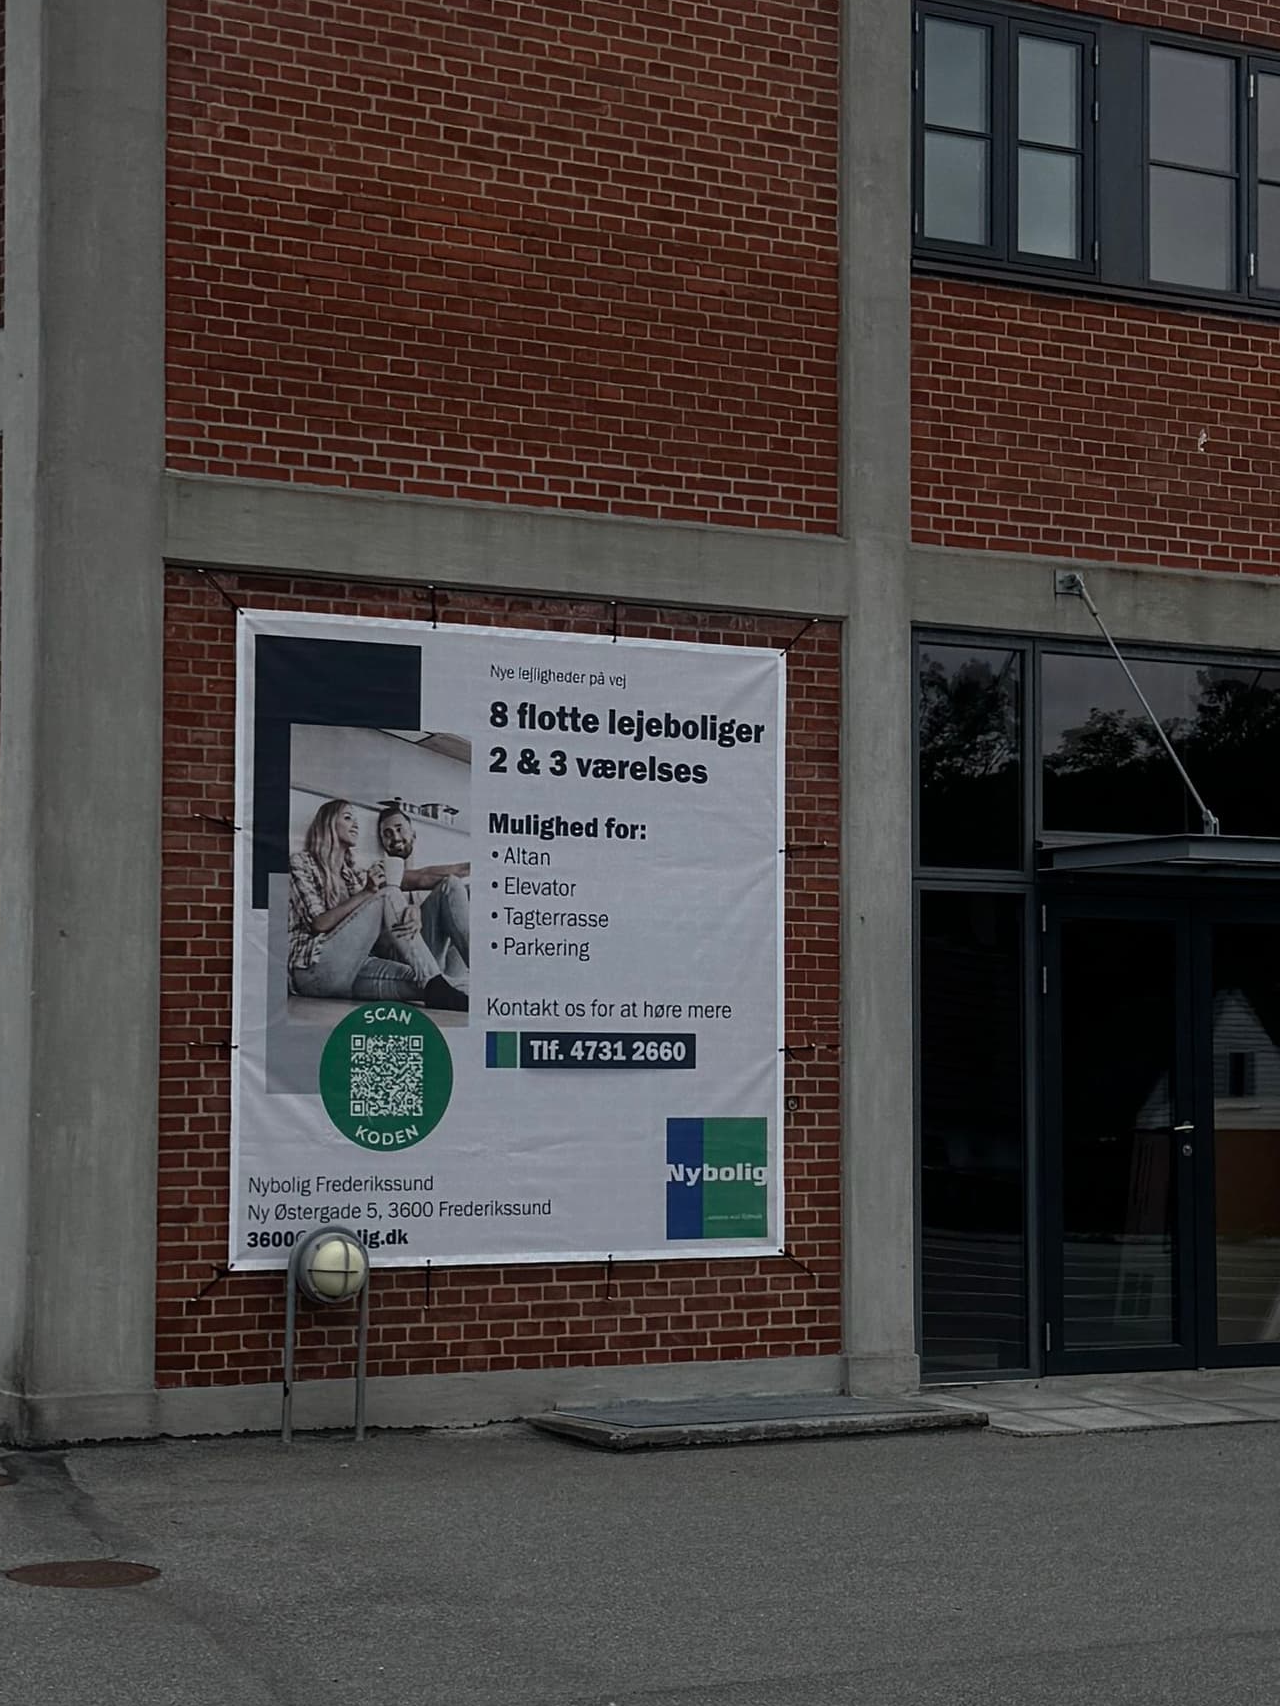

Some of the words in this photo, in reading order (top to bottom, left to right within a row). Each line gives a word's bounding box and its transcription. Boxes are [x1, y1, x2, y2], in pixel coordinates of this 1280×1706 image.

[489, 664, 515, 680] Nye
[518, 666, 586, 685] lejligheder
[589, 671, 605, 687] på
[609, 673, 627, 690] vej
[489, 700, 509, 729] 8
[516, 701, 600, 734] flotte
[608, 708, 765, 748] lejeboliger
[489, 746, 508, 774] 2
[516, 748, 541, 776] &
[548, 749, 568, 777] 3
[575, 755, 709, 784] værelses
[488, 812, 599, 840] Mulighed
[604, 816, 647, 840] for:
[503, 846, 551, 866] Altan
[504, 876, 577, 897] Elevator
[503, 906, 609, 930] Tagterrasse
[503, 937, 590, 962] Parkering
[363, 1007, 412, 1026] SCAN
[486, 997, 560, 1018] Kontakt
[565, 1002, 586, 1018] os
[590, 998, 616, 1018] for
[620, 999, 638, 1018] at
[643, 1000, 682, 1019] høre
[687, 1004, 732, 1019] mere
[529, 1039, 565, 1062] Tlf.
[569, 1040, 626, 1062] 4731
[631, 1040, 687, 1062] 2660
[355, 1124, 420, 1146] KODEN
[248, 1176, 311, 1197] Nybolig
[316, 1175, 434, 1193] Frederikssund
[666, 1162, 768, 1187] Nybolig
[247, 1204, 270, 1224] Ny
[274, 1201, 362, 1224] Østergade
[366, 1202, 383, 1222] 5,
[388, 1201, 434, 1218] 3600
[438, 1199, 552, 1217] Frederikssund
